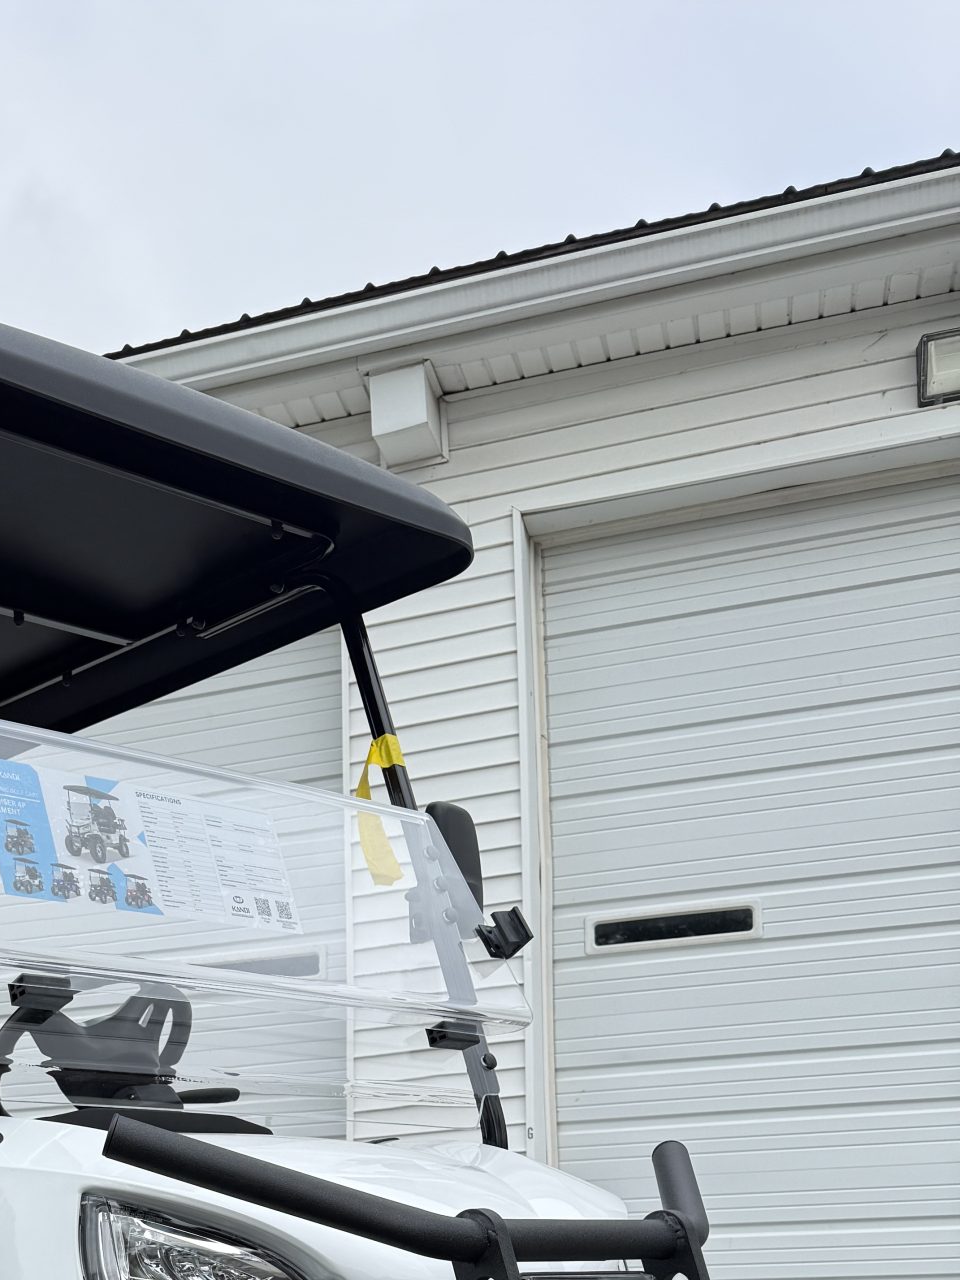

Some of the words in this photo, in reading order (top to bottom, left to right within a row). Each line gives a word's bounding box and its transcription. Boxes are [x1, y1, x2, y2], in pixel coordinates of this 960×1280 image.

[135, 791, 182, 805] SPECIFICATIONS
[232, 905, 251, 914] KANDI
[527, 1126, 534, 1140] G
